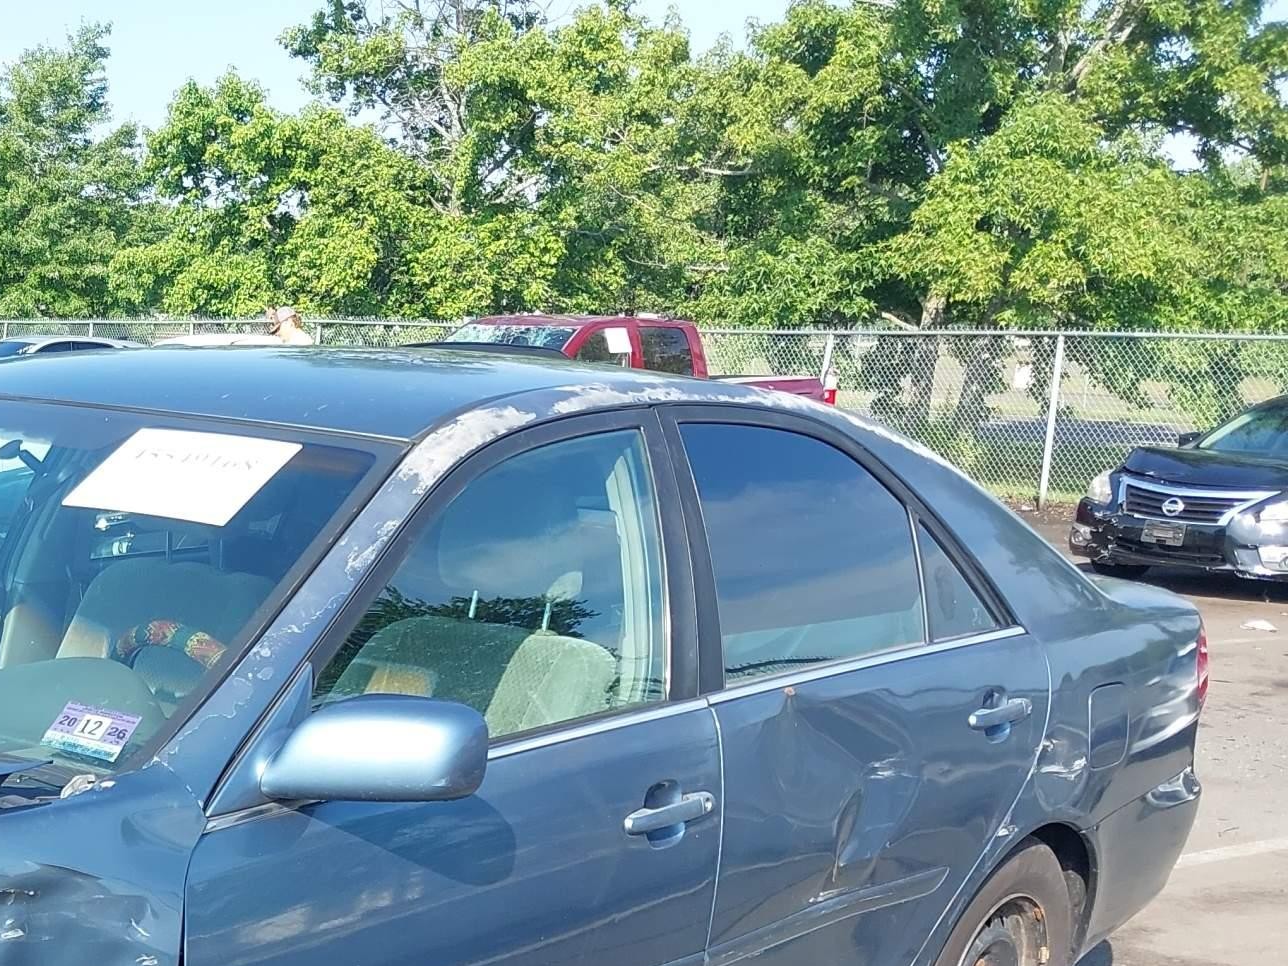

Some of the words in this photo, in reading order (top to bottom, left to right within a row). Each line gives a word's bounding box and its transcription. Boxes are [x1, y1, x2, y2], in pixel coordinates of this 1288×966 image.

[58, 714, 78, 728] 20
[78, 718, 103, 736] 12
[107, 726, 129, 741] 26
